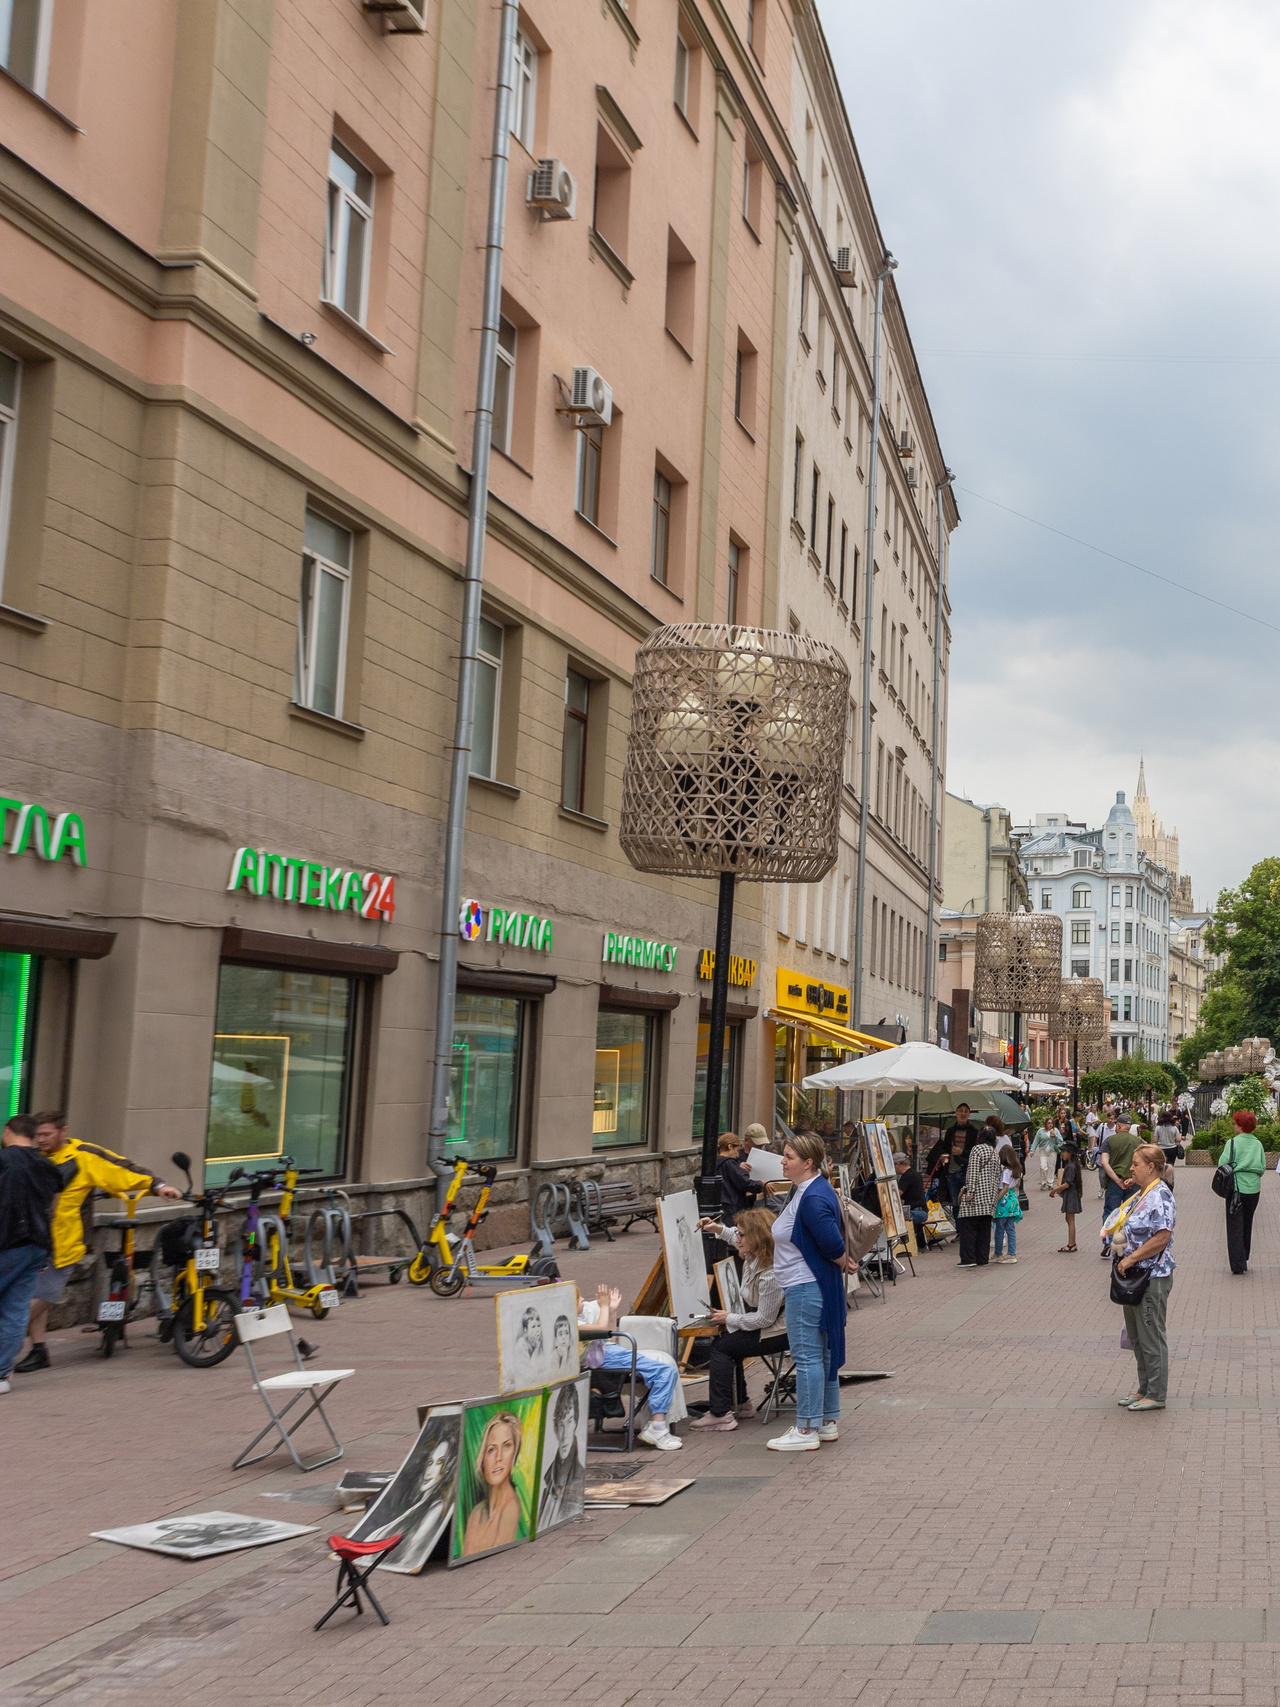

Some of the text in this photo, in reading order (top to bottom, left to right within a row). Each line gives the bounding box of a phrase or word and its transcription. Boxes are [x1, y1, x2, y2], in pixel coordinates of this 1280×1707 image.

[227, 847, 395, 923] АПТЕКА24
[486, 908, 552, 953] РИГЛА
[602, 932, 678, 972] PHARMACY
[698, 949, 757, 988] АНКВАР
